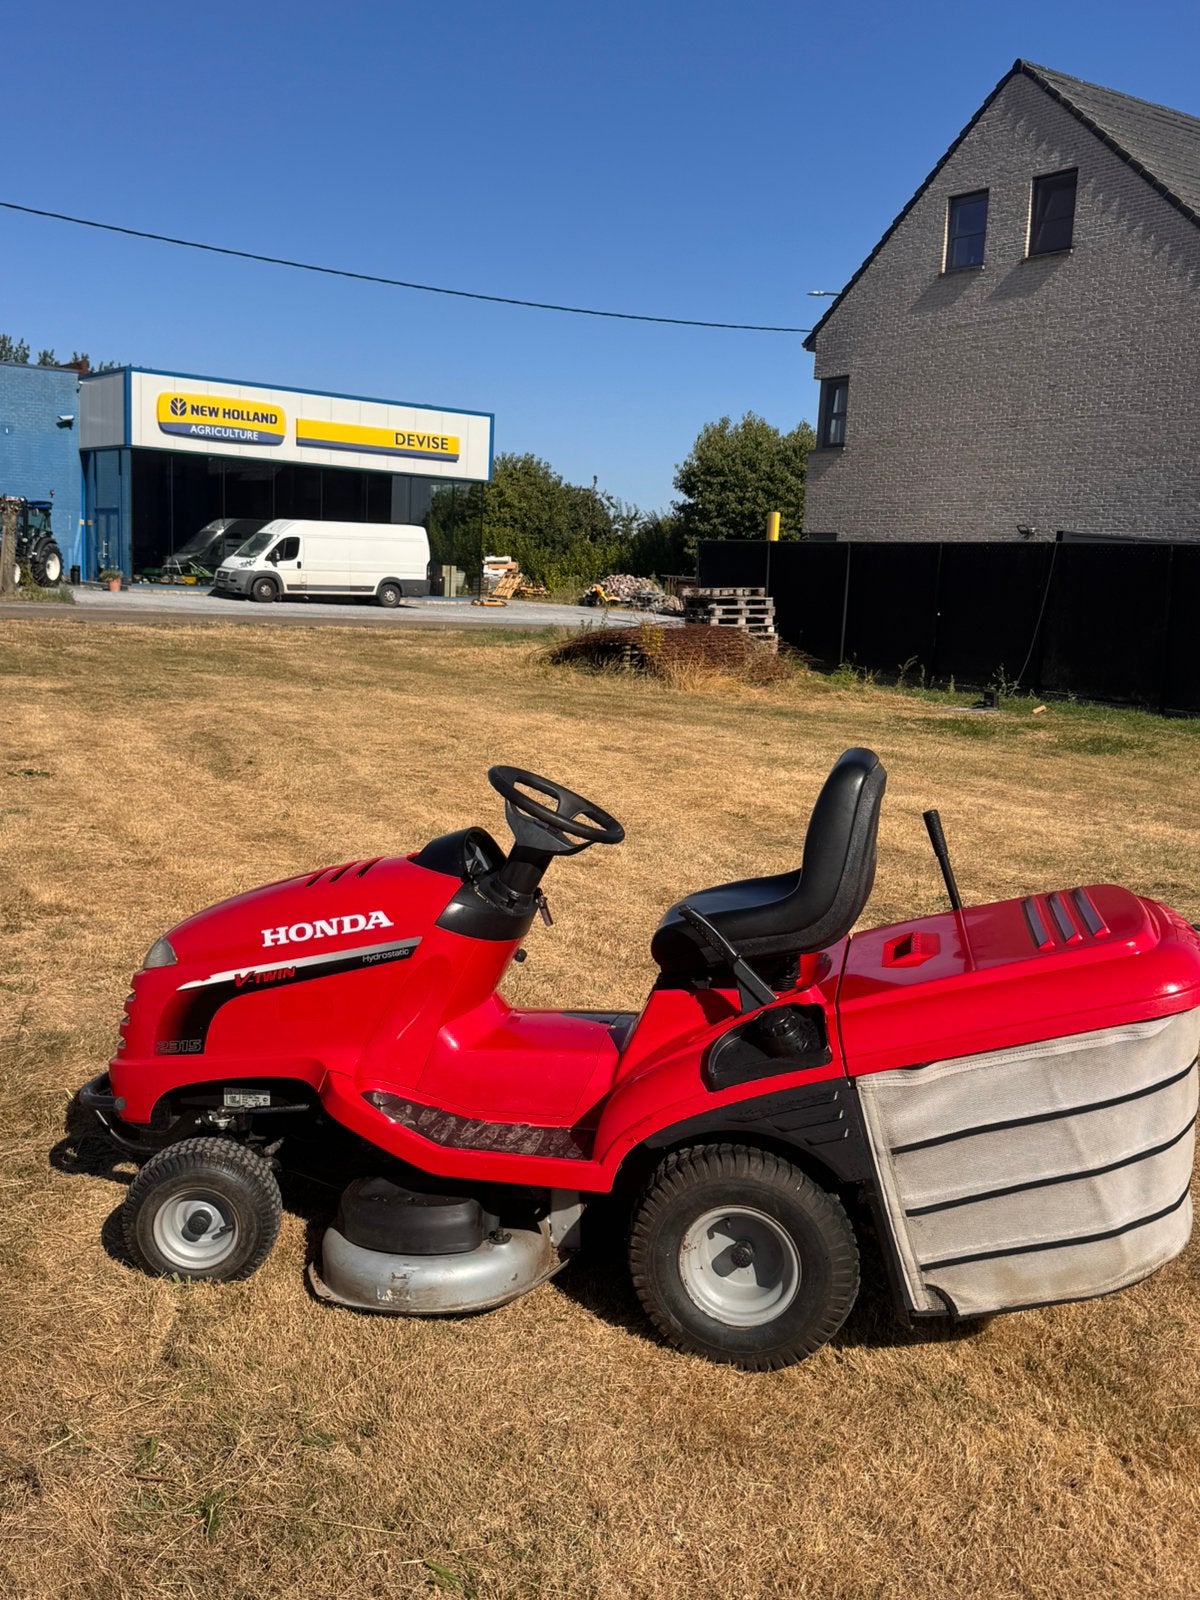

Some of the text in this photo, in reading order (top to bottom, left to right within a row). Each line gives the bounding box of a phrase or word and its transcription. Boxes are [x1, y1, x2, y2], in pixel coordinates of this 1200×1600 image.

[190, 404, 278, 425] NEW HOLLAND
[190, 425, 259, 441] AGRICULTURE
[395, 432, 449, 451] DEVISE
[261, 910, 394, 947] HONDA
[362, 948, 410, 964] Hydrostatic
[234, 966, 296, 988] V-TWIN
[156, 1039, 202, 1054] 2315
